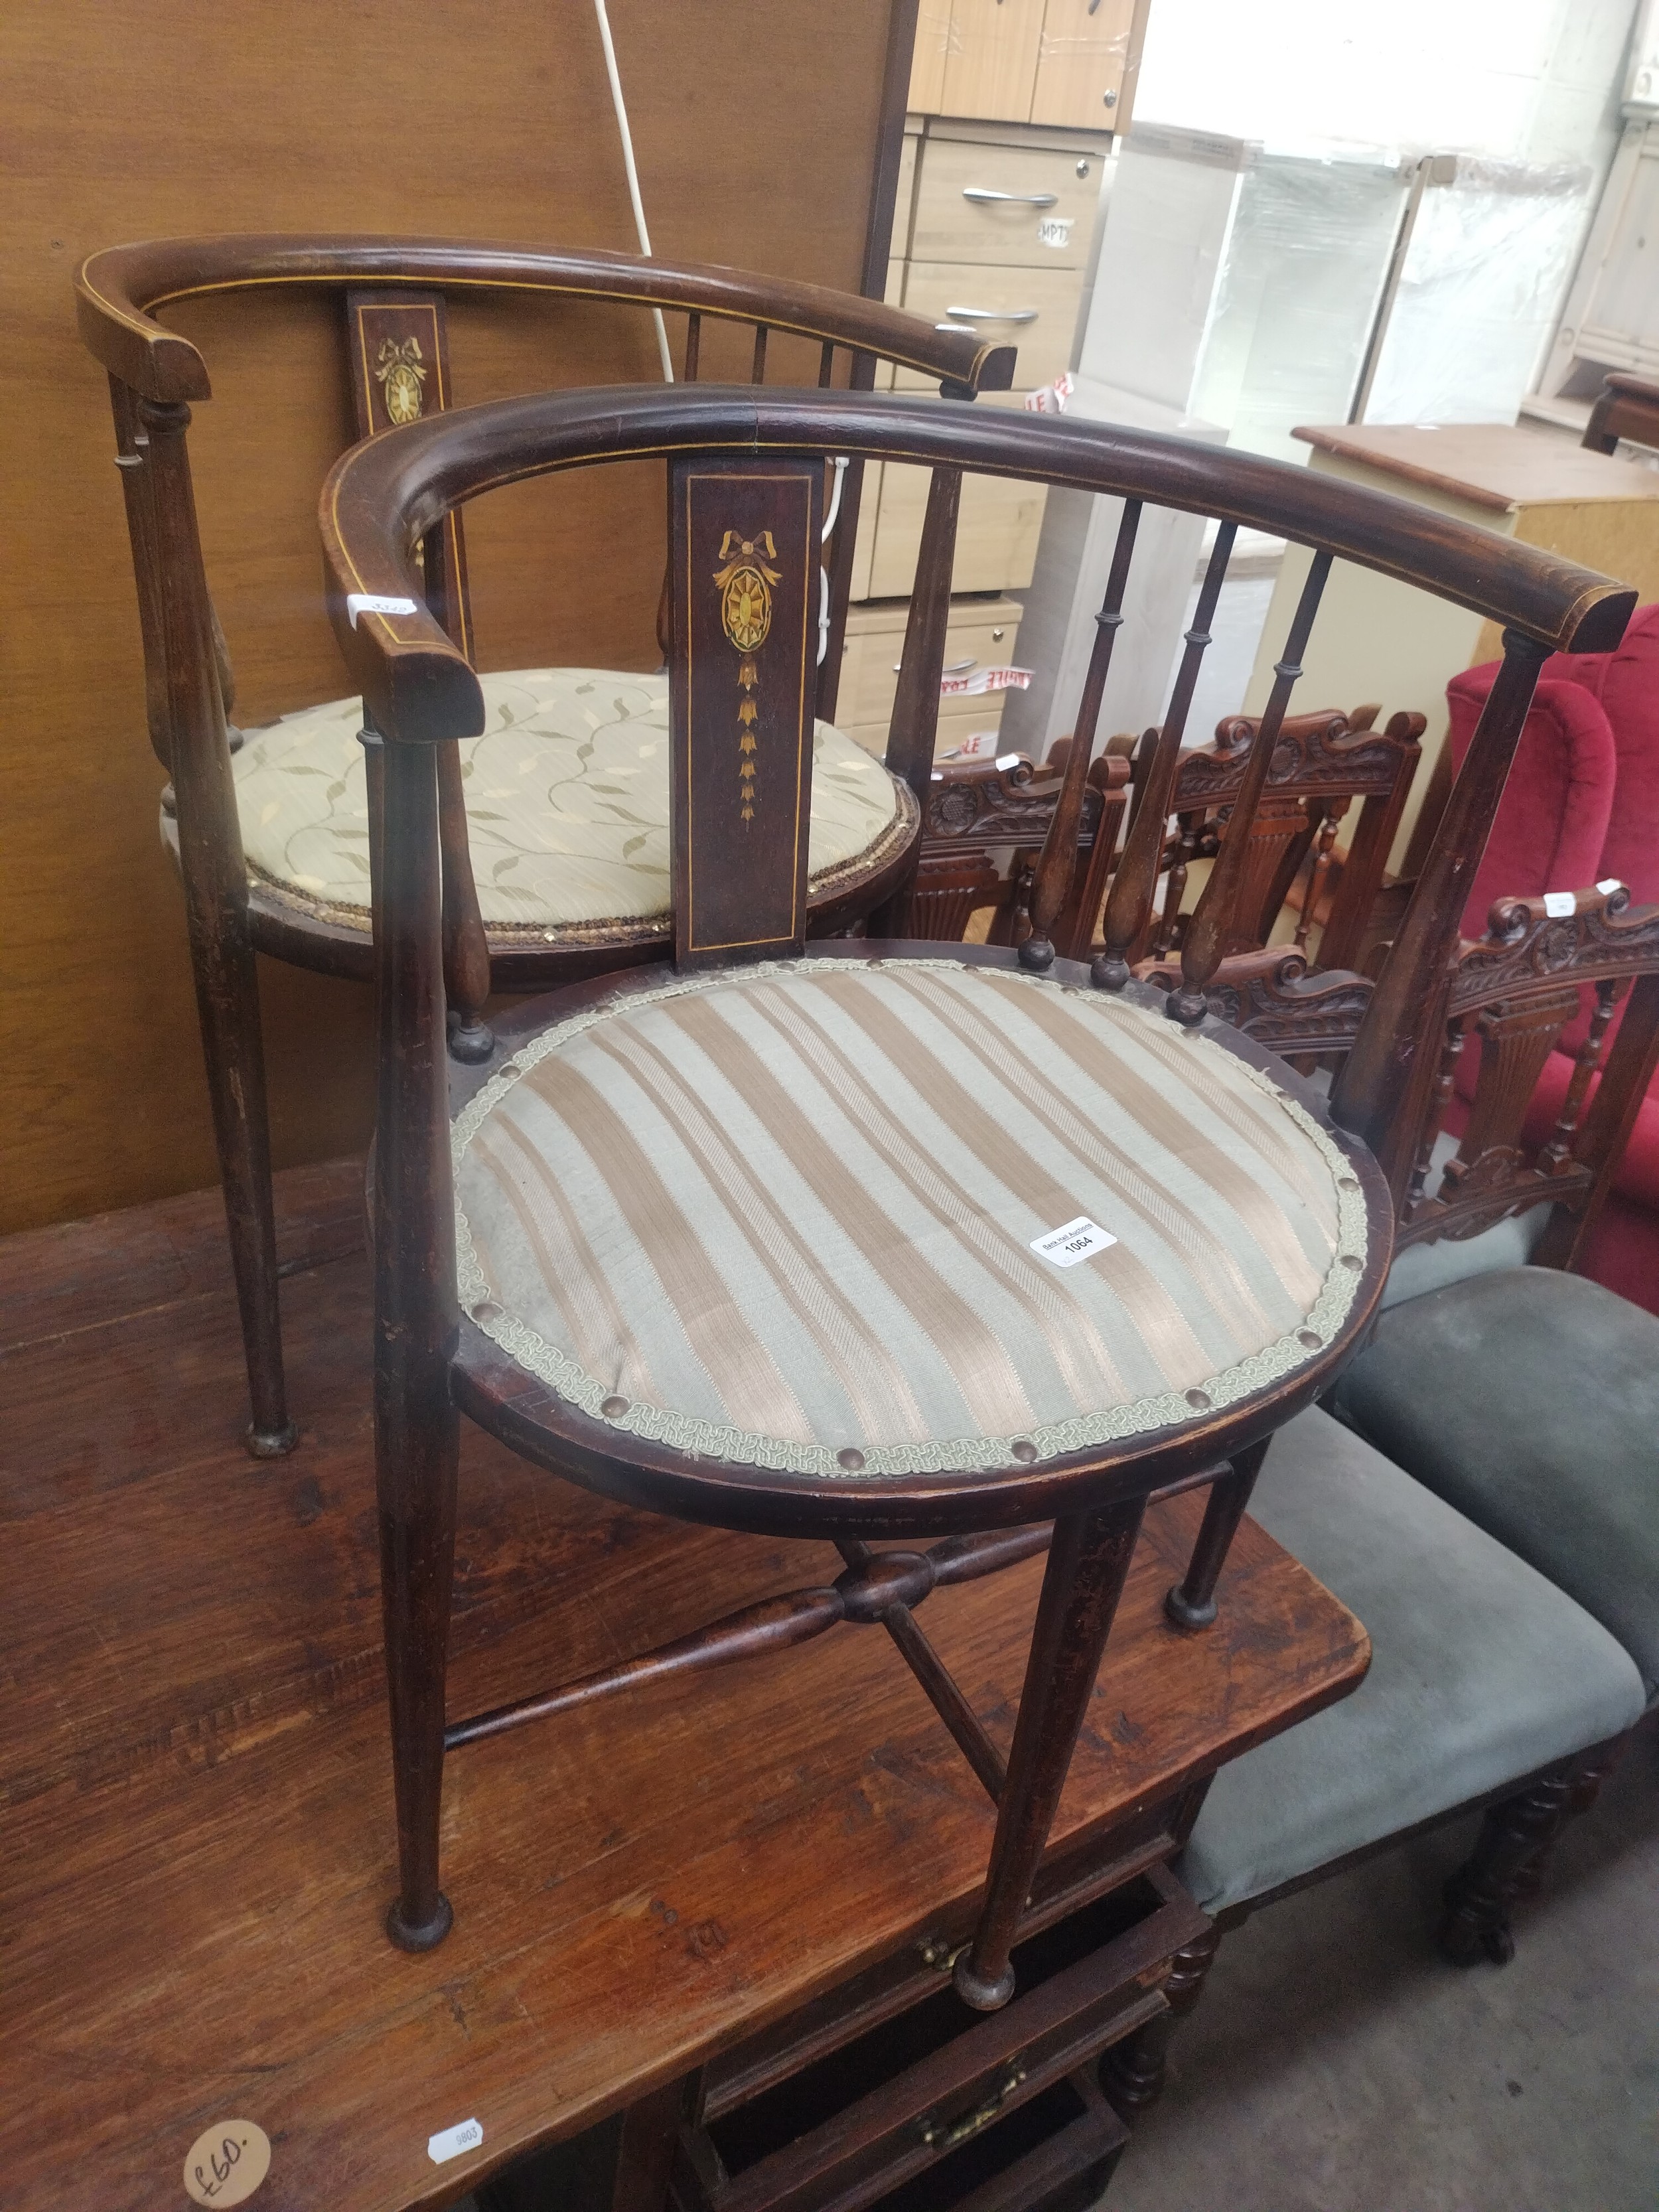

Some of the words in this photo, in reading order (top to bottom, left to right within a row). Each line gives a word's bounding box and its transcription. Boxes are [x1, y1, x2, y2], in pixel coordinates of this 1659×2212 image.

[1043, 1238, 1058, 1250] Bank
[1056, 1232, 1070, 1243] Hall
[1068, 1222, 1093, 1237] Auctions
[1065, 1236, 1094, 1253] 1064
[456, 2126, 478, 2146] 9803
